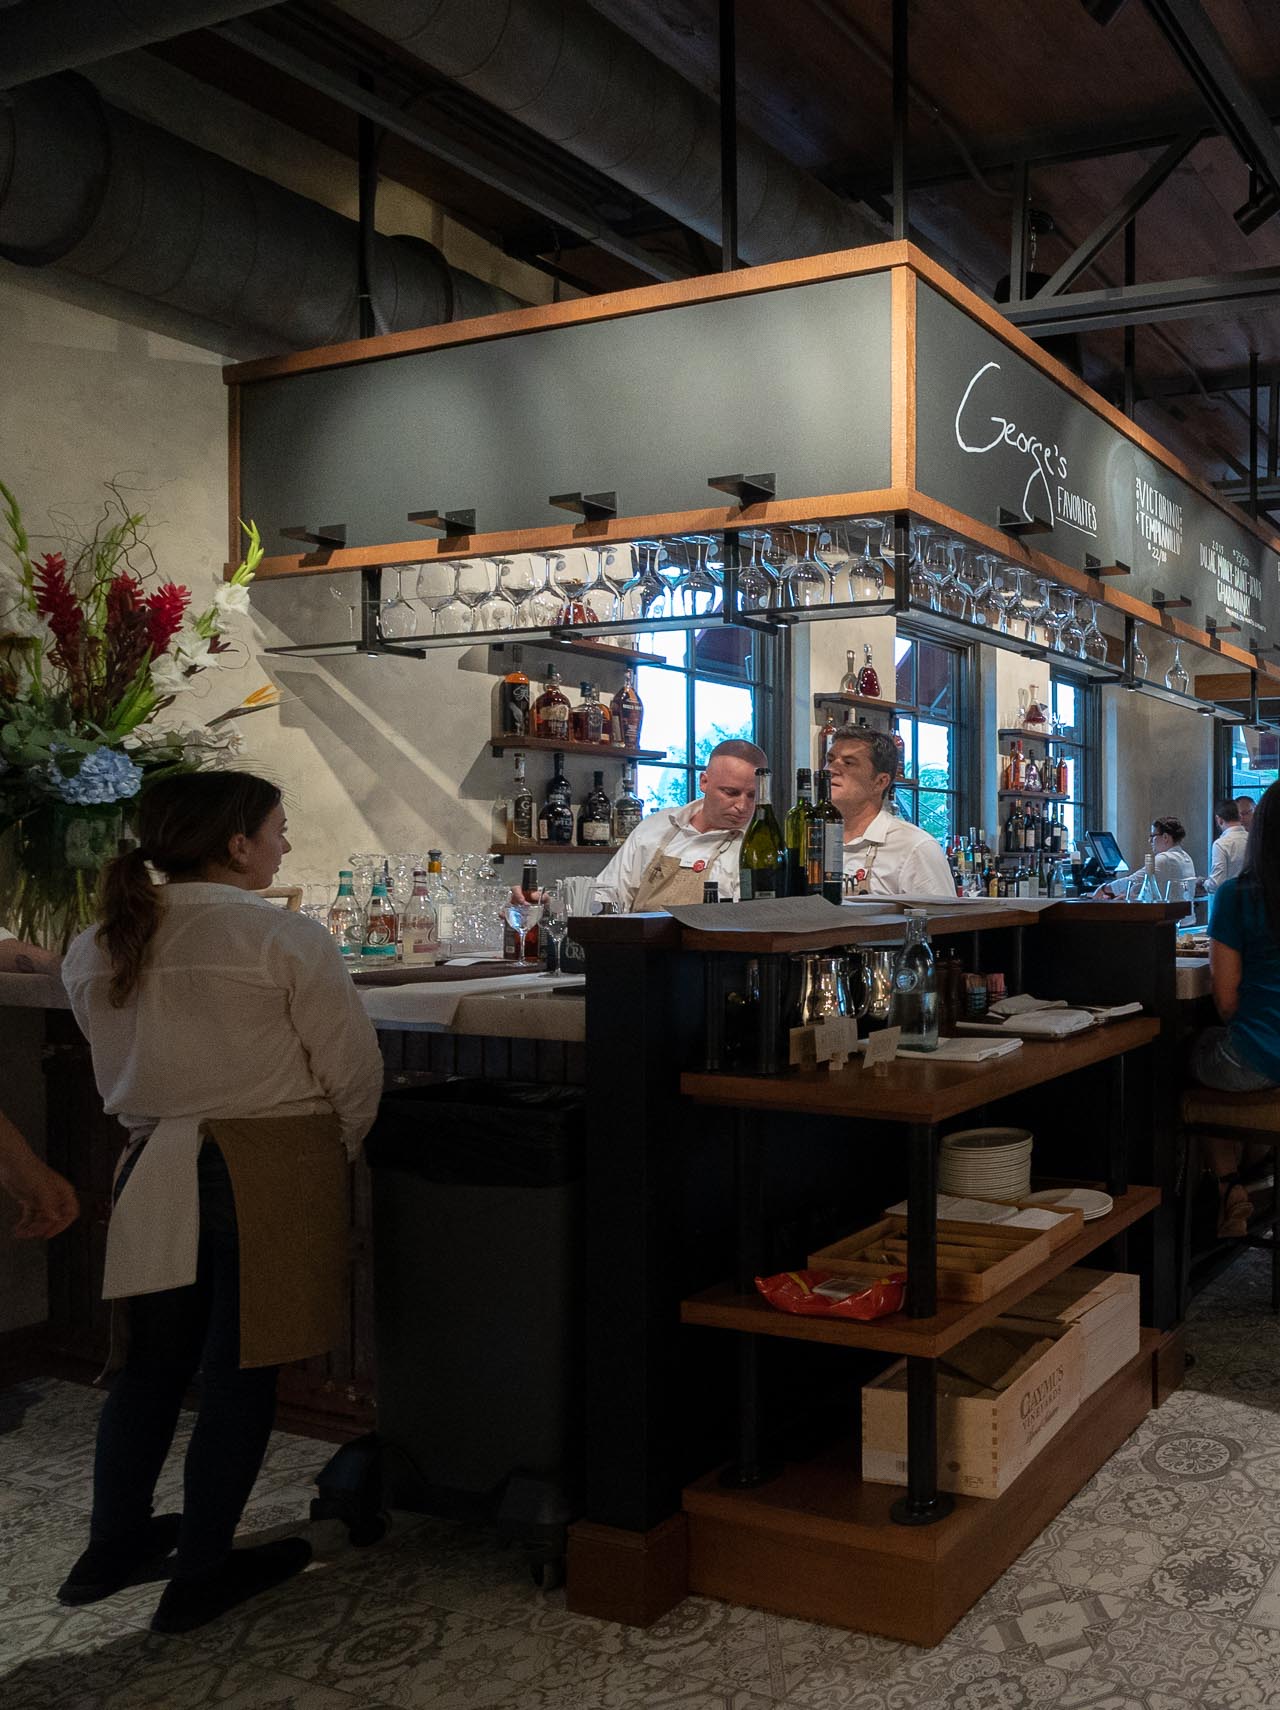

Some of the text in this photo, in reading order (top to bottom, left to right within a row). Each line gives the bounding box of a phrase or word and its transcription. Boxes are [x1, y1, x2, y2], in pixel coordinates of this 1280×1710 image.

[955, 361, 1067, 527] George's
[1057, 486, 1097, 531] FAVORITES
[1138, 480, 1180, 530] VICTORINO
